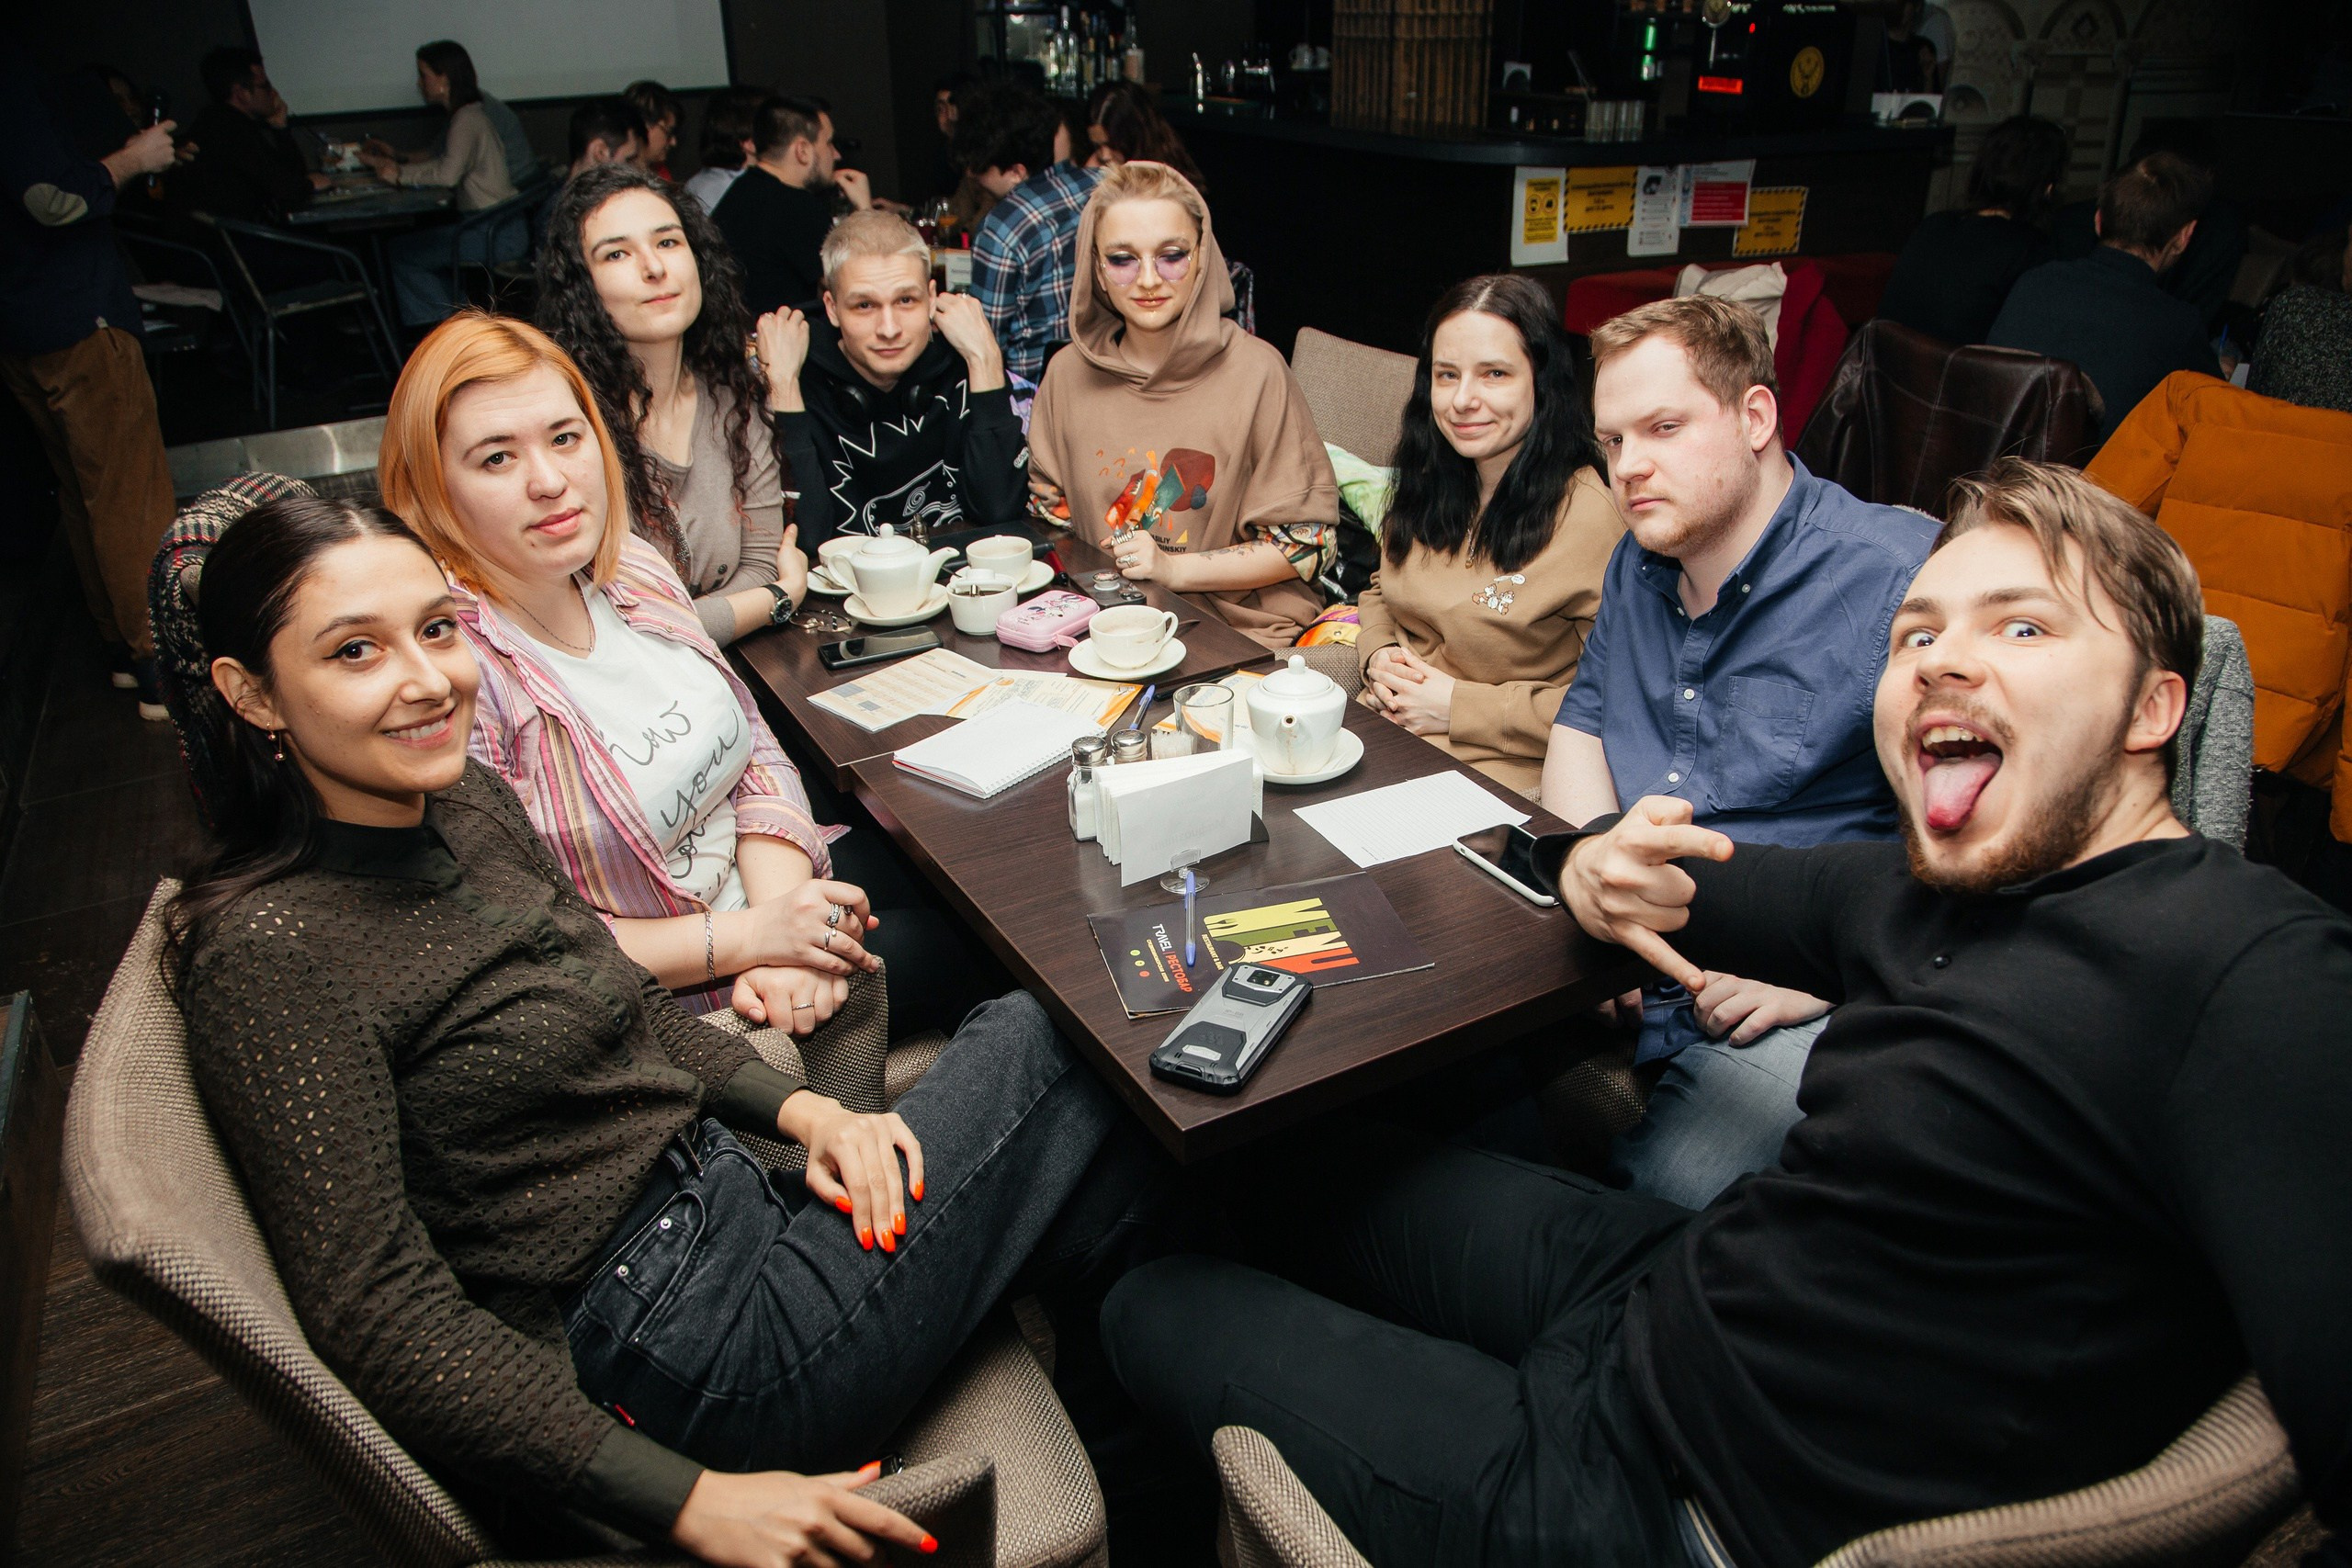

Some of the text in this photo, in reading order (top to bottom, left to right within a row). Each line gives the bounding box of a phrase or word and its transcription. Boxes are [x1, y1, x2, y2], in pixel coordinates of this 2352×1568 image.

[1150, 534, 1170, 545] ASILIY
[1152, 923, 1172, 953] TRAVEL
[1165, 953, 1193, 994] РЕСТОБАР
[1204, 897, 1360, 974] MENU
